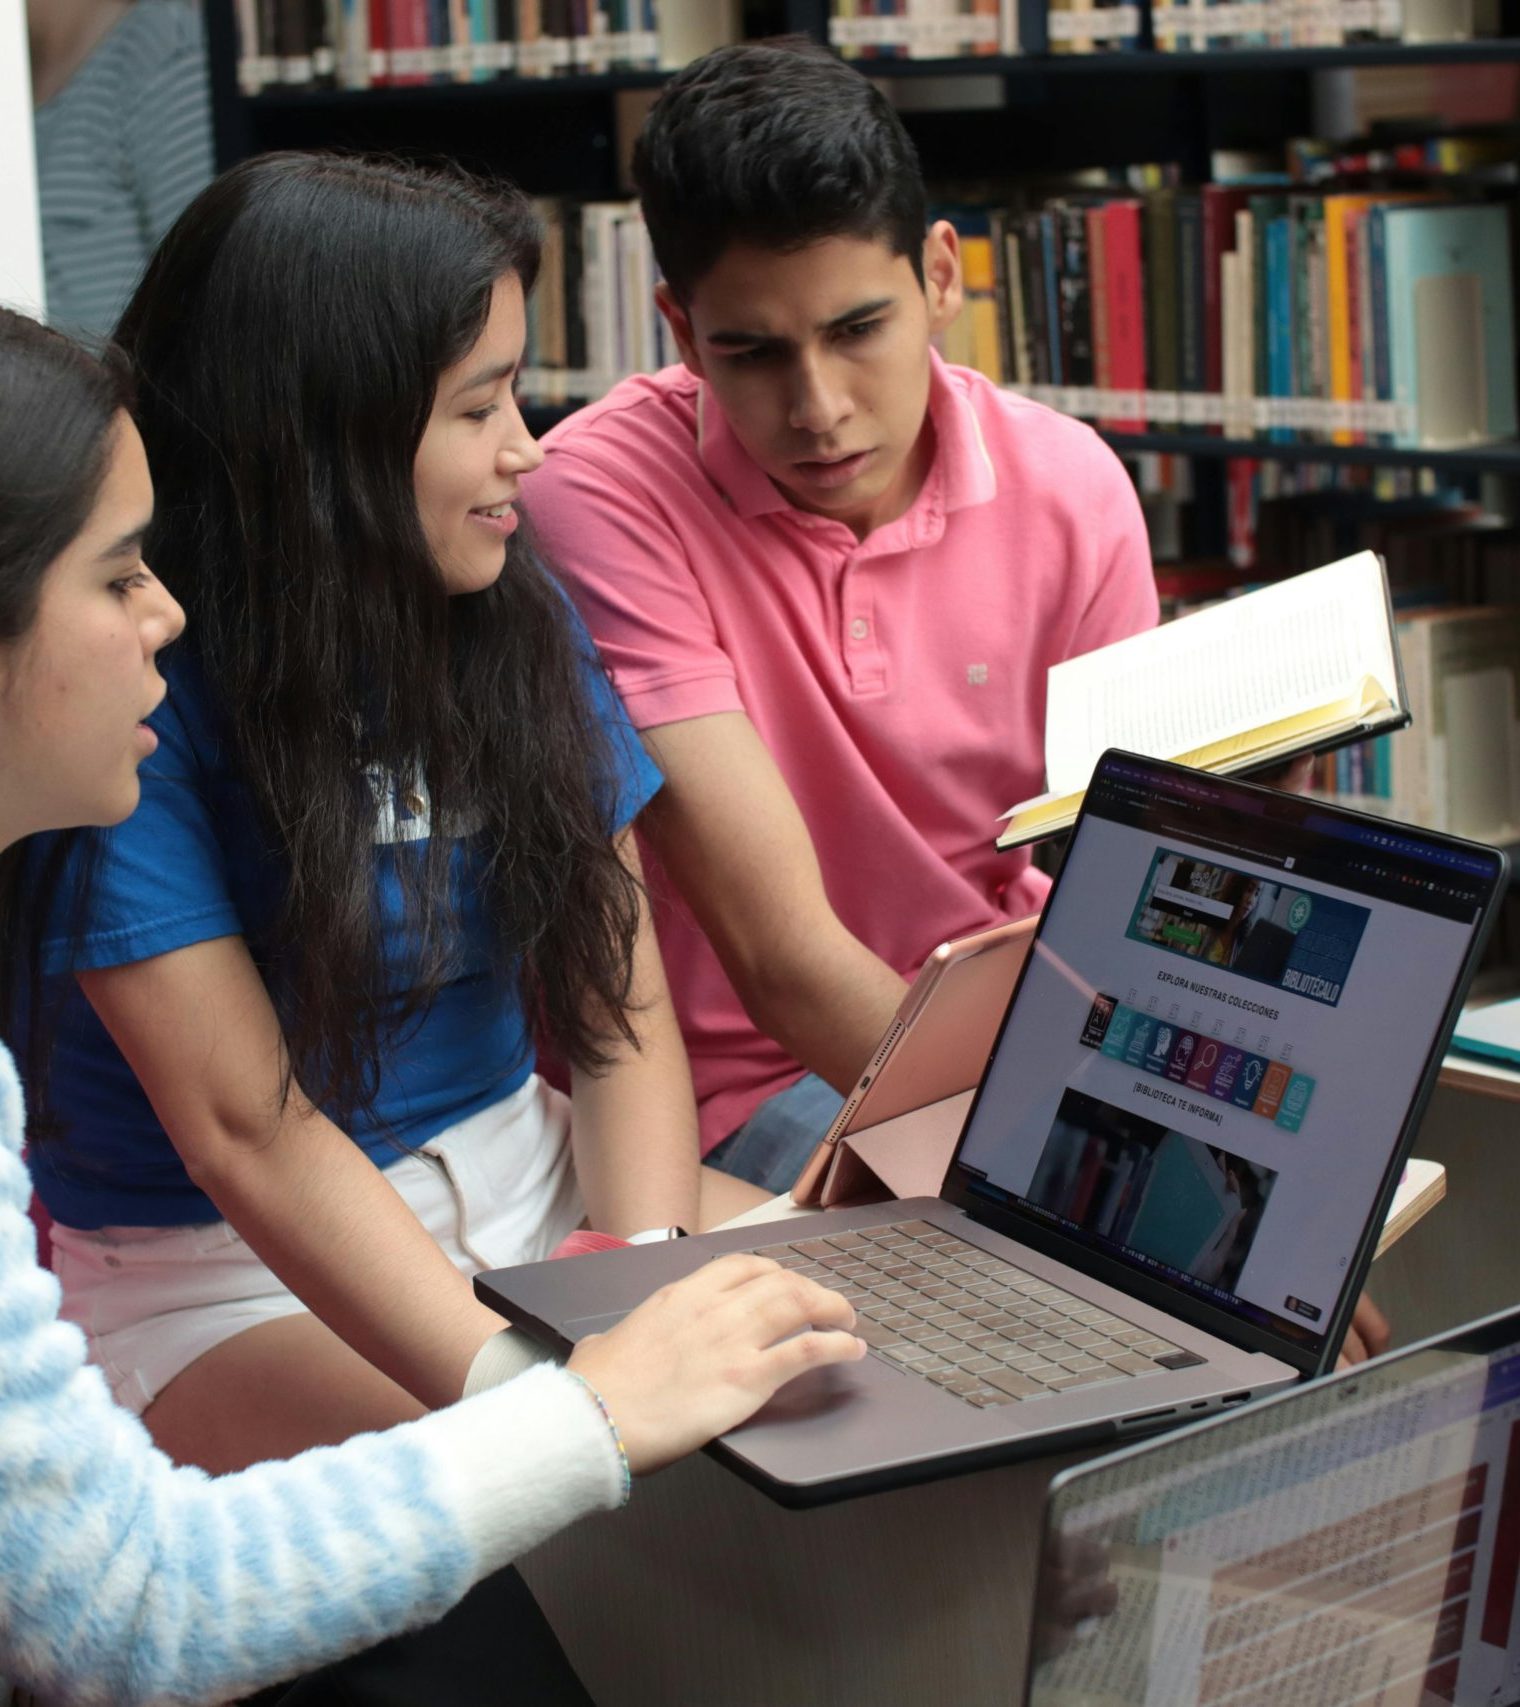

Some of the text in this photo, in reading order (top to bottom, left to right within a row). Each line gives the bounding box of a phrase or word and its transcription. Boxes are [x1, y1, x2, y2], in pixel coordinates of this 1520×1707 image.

[1157, 970, 1280, 1020] EXPLORA NUESTRAS COLECCIONES
[1177, 1099, 1188, 1110] TE
